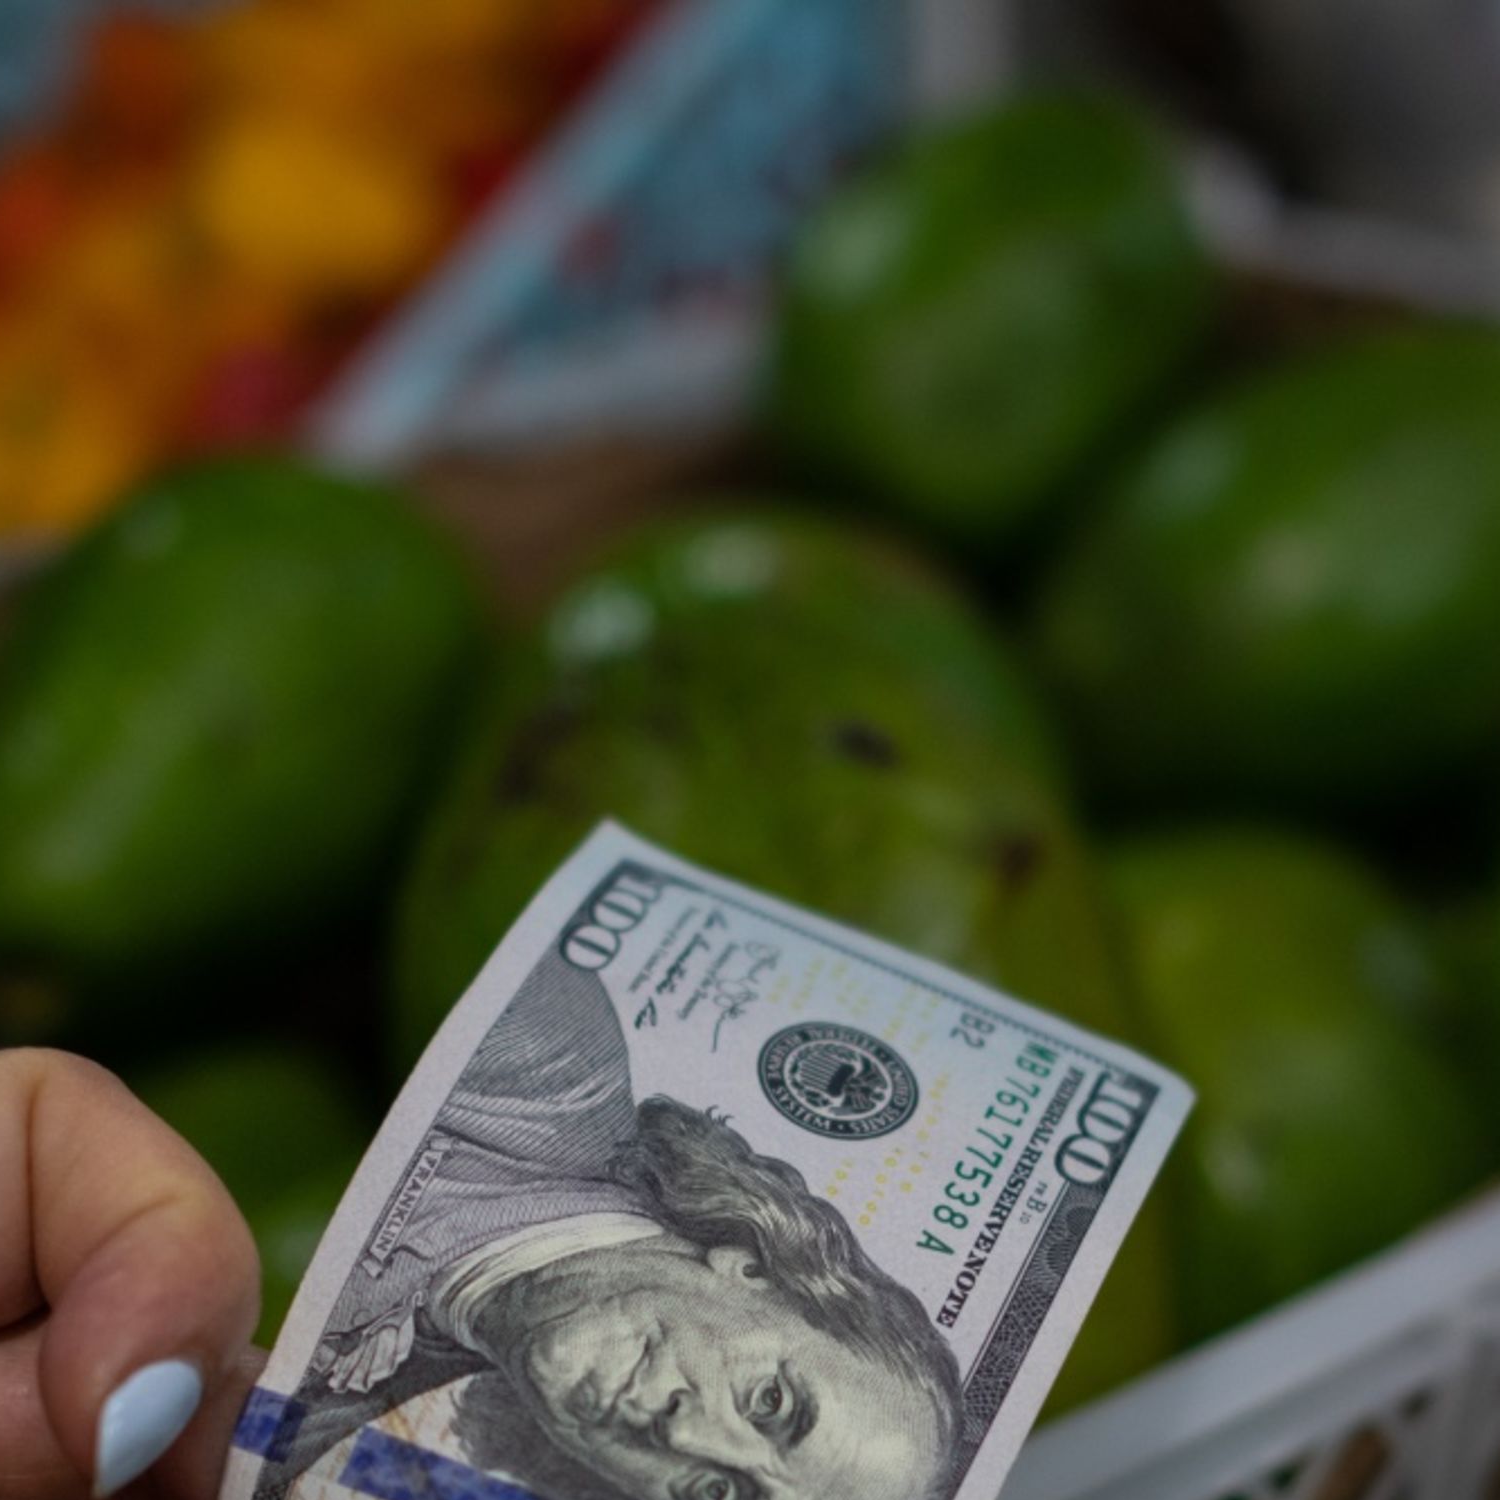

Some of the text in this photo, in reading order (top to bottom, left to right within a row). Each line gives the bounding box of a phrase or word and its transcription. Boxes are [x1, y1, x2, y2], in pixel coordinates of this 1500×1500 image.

[561, 870, 661, 975] 100
[1053, 1070, 1146, 1189] 100
[374, 1153, 437, 1254] FRANKLIN
[915, 1229, 956, 1262] A
[934, 1066, 1084, 1329] FEDERAL RESERVE NOTE
[1024, 1195, 1047, 1215] B
